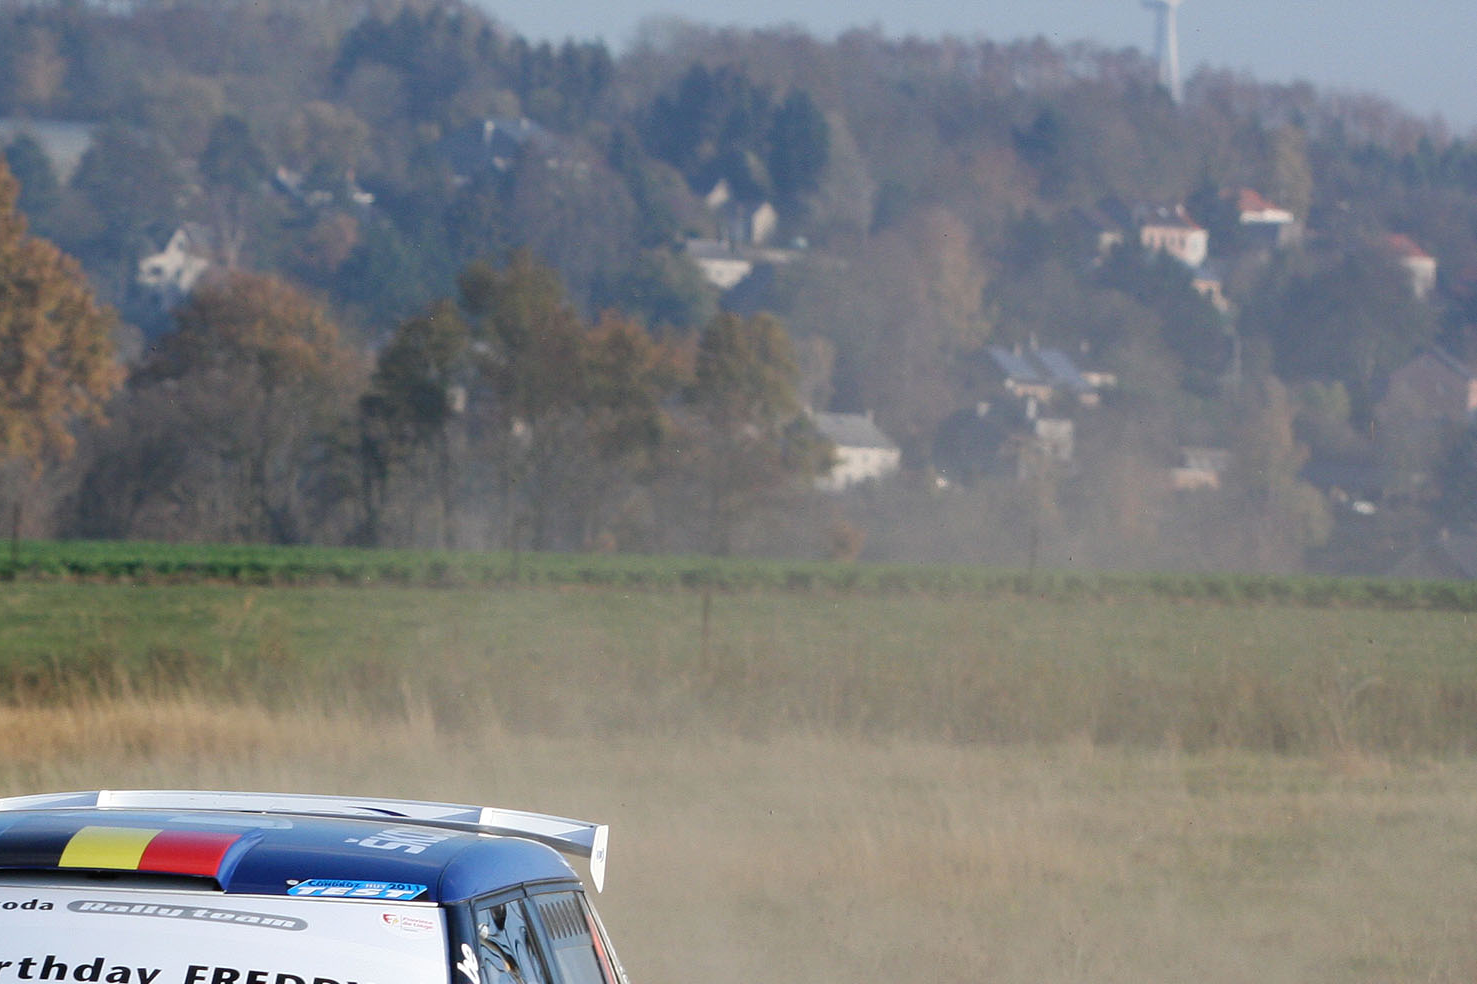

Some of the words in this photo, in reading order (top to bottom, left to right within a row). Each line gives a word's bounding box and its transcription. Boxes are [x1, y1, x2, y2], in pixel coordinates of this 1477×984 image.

[296, 886, 415, 899] TEST
[389, 882, 421, 892] 2011
[78, 901, 184, 918] Rally
[191, 908, 297, 929] team
